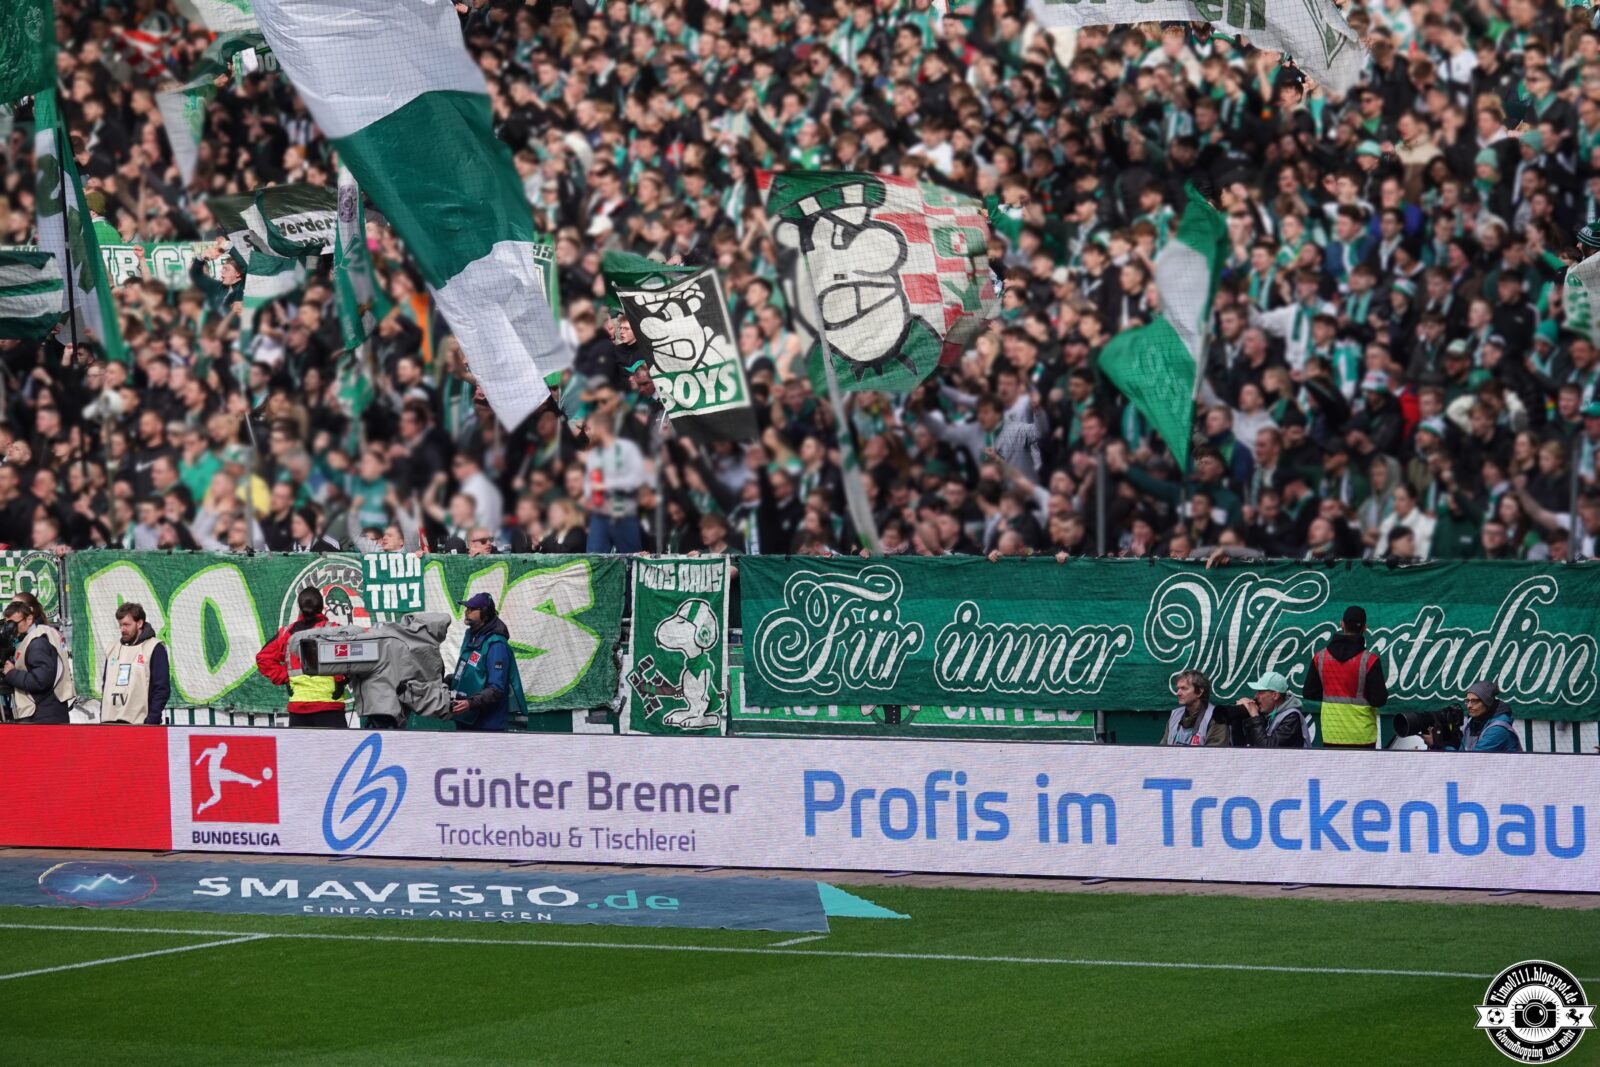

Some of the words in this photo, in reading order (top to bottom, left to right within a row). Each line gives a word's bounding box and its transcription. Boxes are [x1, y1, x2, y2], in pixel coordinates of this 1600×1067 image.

[652, 363, 737, 412] BOYS
[678, 561, 724, 593] RAUS
[753, 564, 924, 695] Für
[934, 600, 1133, 694] immer
[111, 693, 129, 706] TV
[433, 767, 573, 810] Günter
[587, 770, 740, 814] Bremer
[803, 769, 1010, 842] Profis
[1035, 772, 1118, 846] im
[1142, 777, 1587, 860] Trockenbau
[191, 830, 281, 847] BUNDESLIGA
[436, 823, 561, 849] Trockenbau
[568, 826, 583, 849] &
[590, 827, 696, 852] Tischlerei
[193, 876, 680, 911] SMAVESTO.de
[303, 905, 415, 917] EINFACH
[428, 909, 553, 921] ANLEGEN
